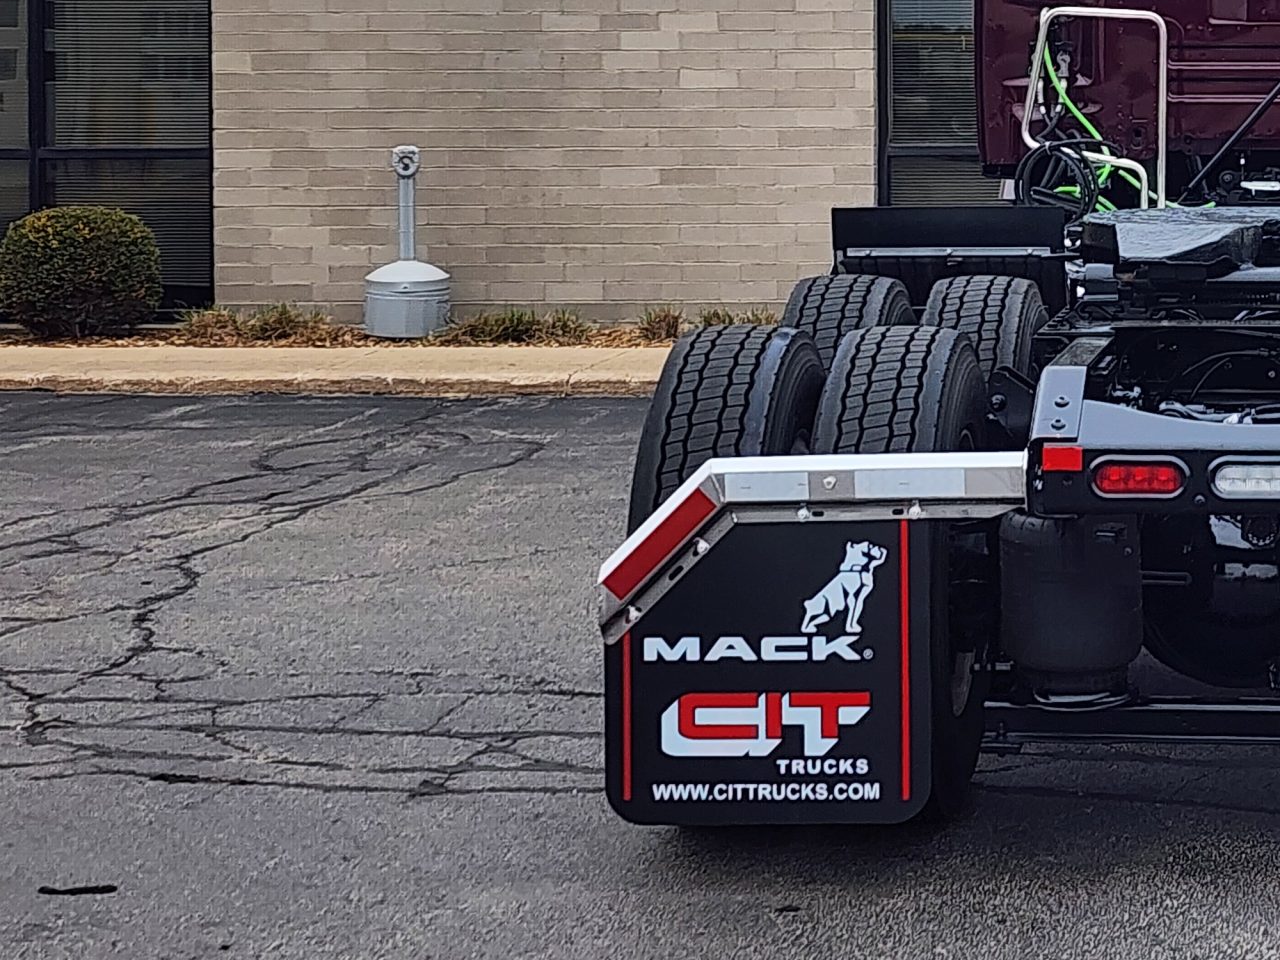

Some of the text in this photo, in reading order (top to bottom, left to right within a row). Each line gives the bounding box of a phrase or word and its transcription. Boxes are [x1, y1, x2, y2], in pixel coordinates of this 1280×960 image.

[643, 635, 862, 662] MACK
[676, 690, 872, 741] CIT
[776, 758, 869, 775] TRUCKS
[652, 782, 880, 801] WWW.CITTRUCKS.COM
